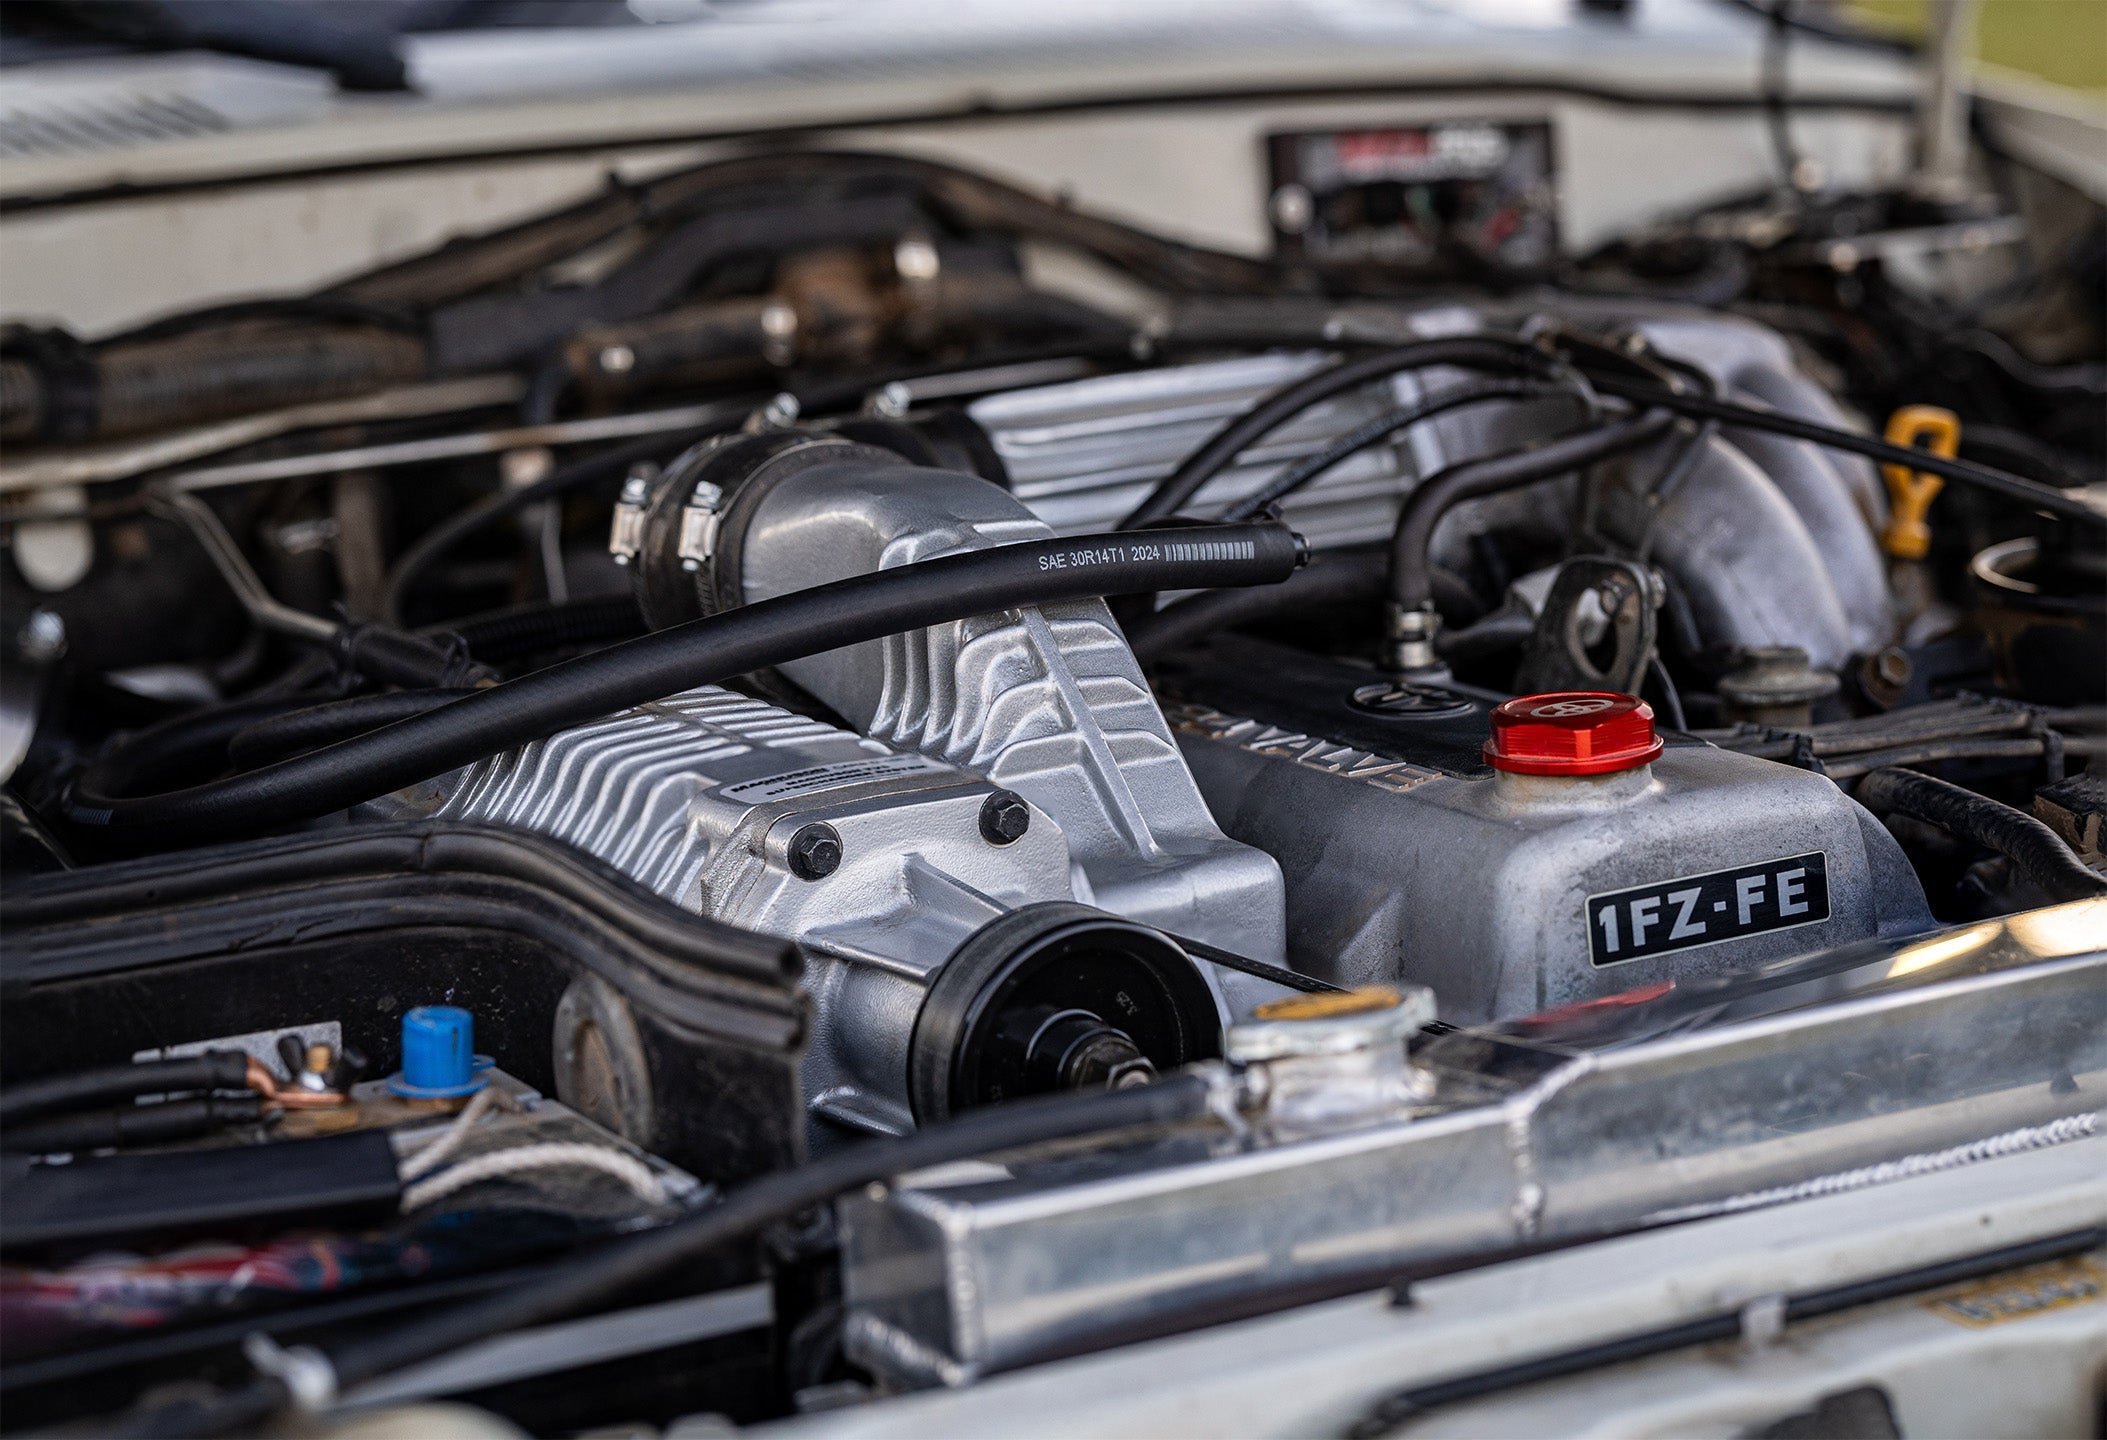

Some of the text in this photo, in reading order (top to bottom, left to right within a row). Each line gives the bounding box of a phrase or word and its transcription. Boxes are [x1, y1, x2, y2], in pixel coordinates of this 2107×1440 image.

[1038, 545, 1161, 571] SAE 30R14T1 2024
[731, 767, 829, 793] MAGNUSON
